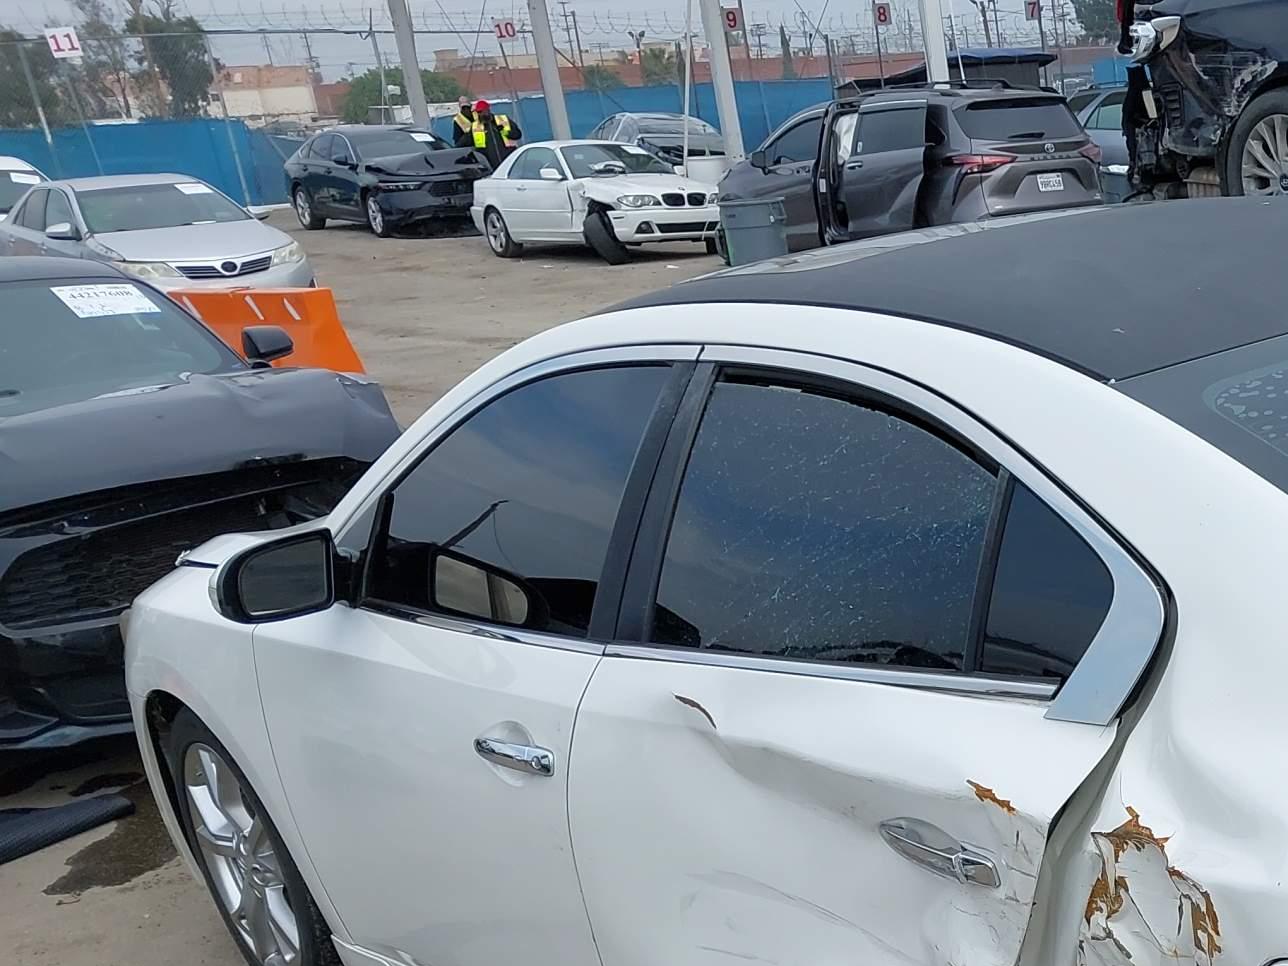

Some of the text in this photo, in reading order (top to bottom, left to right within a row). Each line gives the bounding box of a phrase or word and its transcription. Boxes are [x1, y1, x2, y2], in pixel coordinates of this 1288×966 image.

[877, 6, 887, 22] 8
[1028, 2, 1036, 17] 7
[726, 11, 736, 28] 9
[495, 22, 515, 38] 10
[49, 33, 79, 52] 11
